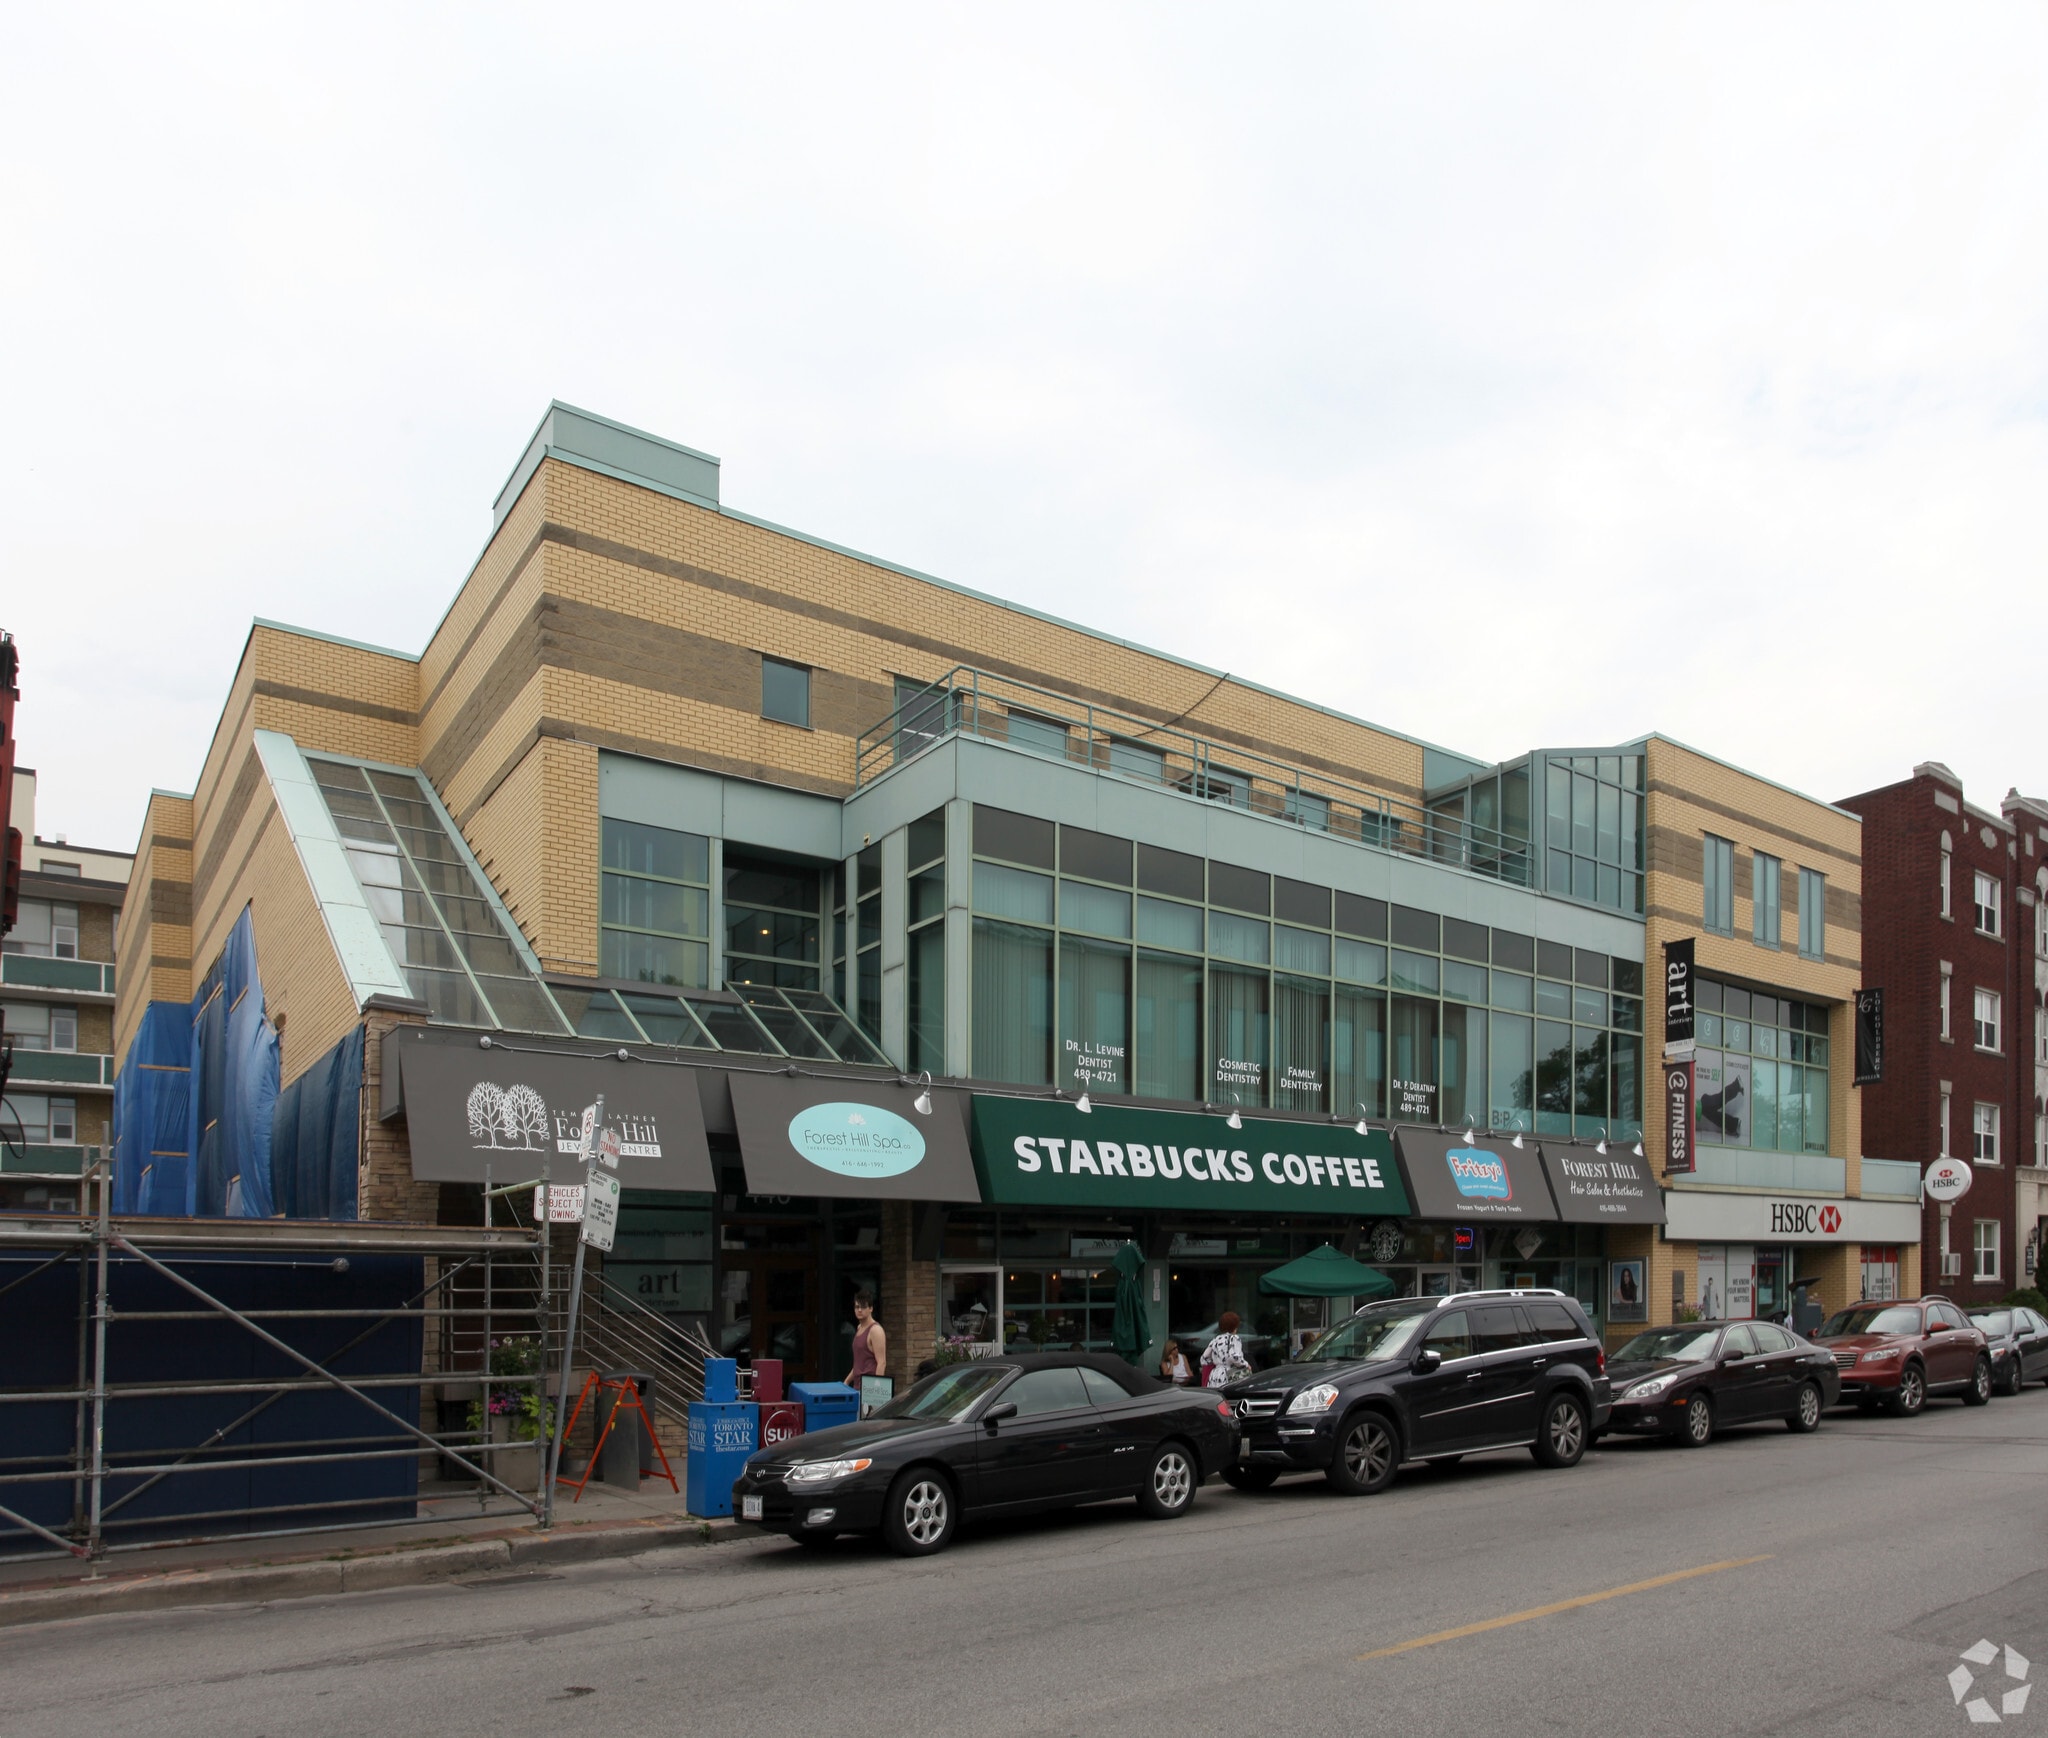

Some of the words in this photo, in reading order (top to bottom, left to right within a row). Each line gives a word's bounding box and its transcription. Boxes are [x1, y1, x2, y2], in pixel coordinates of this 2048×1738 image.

[1668, 962, 1692, 1017] art
[1074, 1068, 1116, 1083] 489-4721
[608, 1113, 656, 1122] LATNER
[621, 1121, 659, 1143] Hill
[1672, 1094, 1685, 1160] FITNESS
[804, 1129, 847, 1146] Forest
[850, 1132, 870, 1147] Hill
[621, 1144, 658, 1155] ENTRE
[1013, 1136, 1254, 1183] STARBUCKS
[1261, 1152, 1385, 1189] COFFEE
[1450, 1156, 1503, 1183] Fritzy's
[1570, 1180, 1584, 1195] Hair
[1585, 1182, 1603, 1196] Salon
[1603, 1183, 1611, 1196] &
[1612, 1182, 1644, 1197] Aesthetics
[1932, 1177, 1960, 1188] HSBC
[548, 1187, 580, 1198] EHICLES
[538, 1197, 572, 1208] SBJECT
[575, 1199, 583, 1208] TO
[1771, 1203, 1817, 1233] HSBC
[638, 1269, 681, 1294] art
[713, 1422, 753, 1432] TORONTO
[714, 1431, 751, 1445] STAR
[715, 1445, 750, 1453] thestar.com
